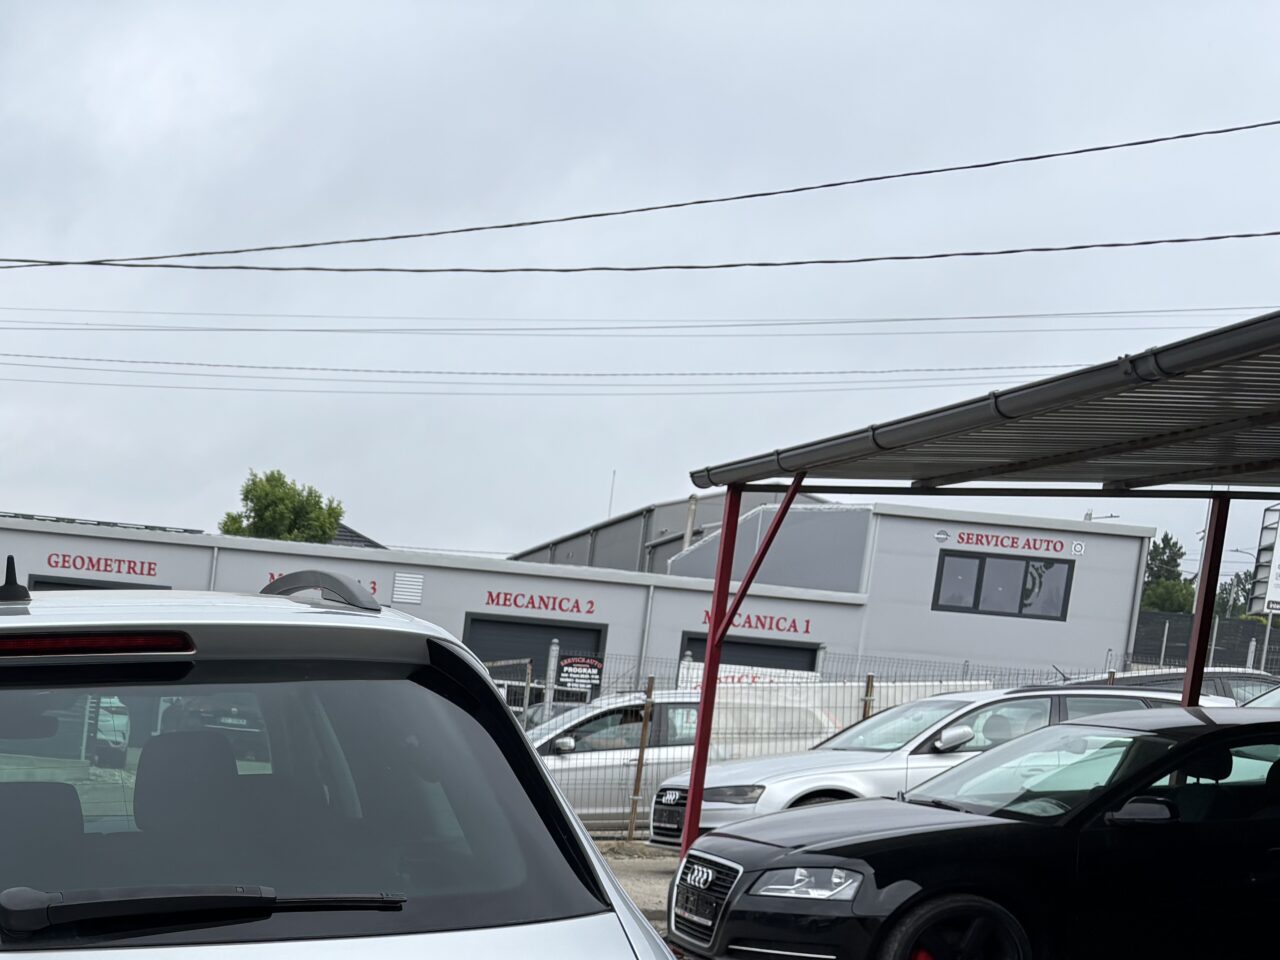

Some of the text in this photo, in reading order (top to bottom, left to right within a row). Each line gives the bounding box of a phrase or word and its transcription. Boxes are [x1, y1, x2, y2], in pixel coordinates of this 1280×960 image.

[957, 532, 1064, 553] SERVICE AUTO
[47, 553, 157, 576] GEOMETRIE
[485, 591, 596, 614] MECANICA 2
[702, 610, 811, 634] MCANICA 1
